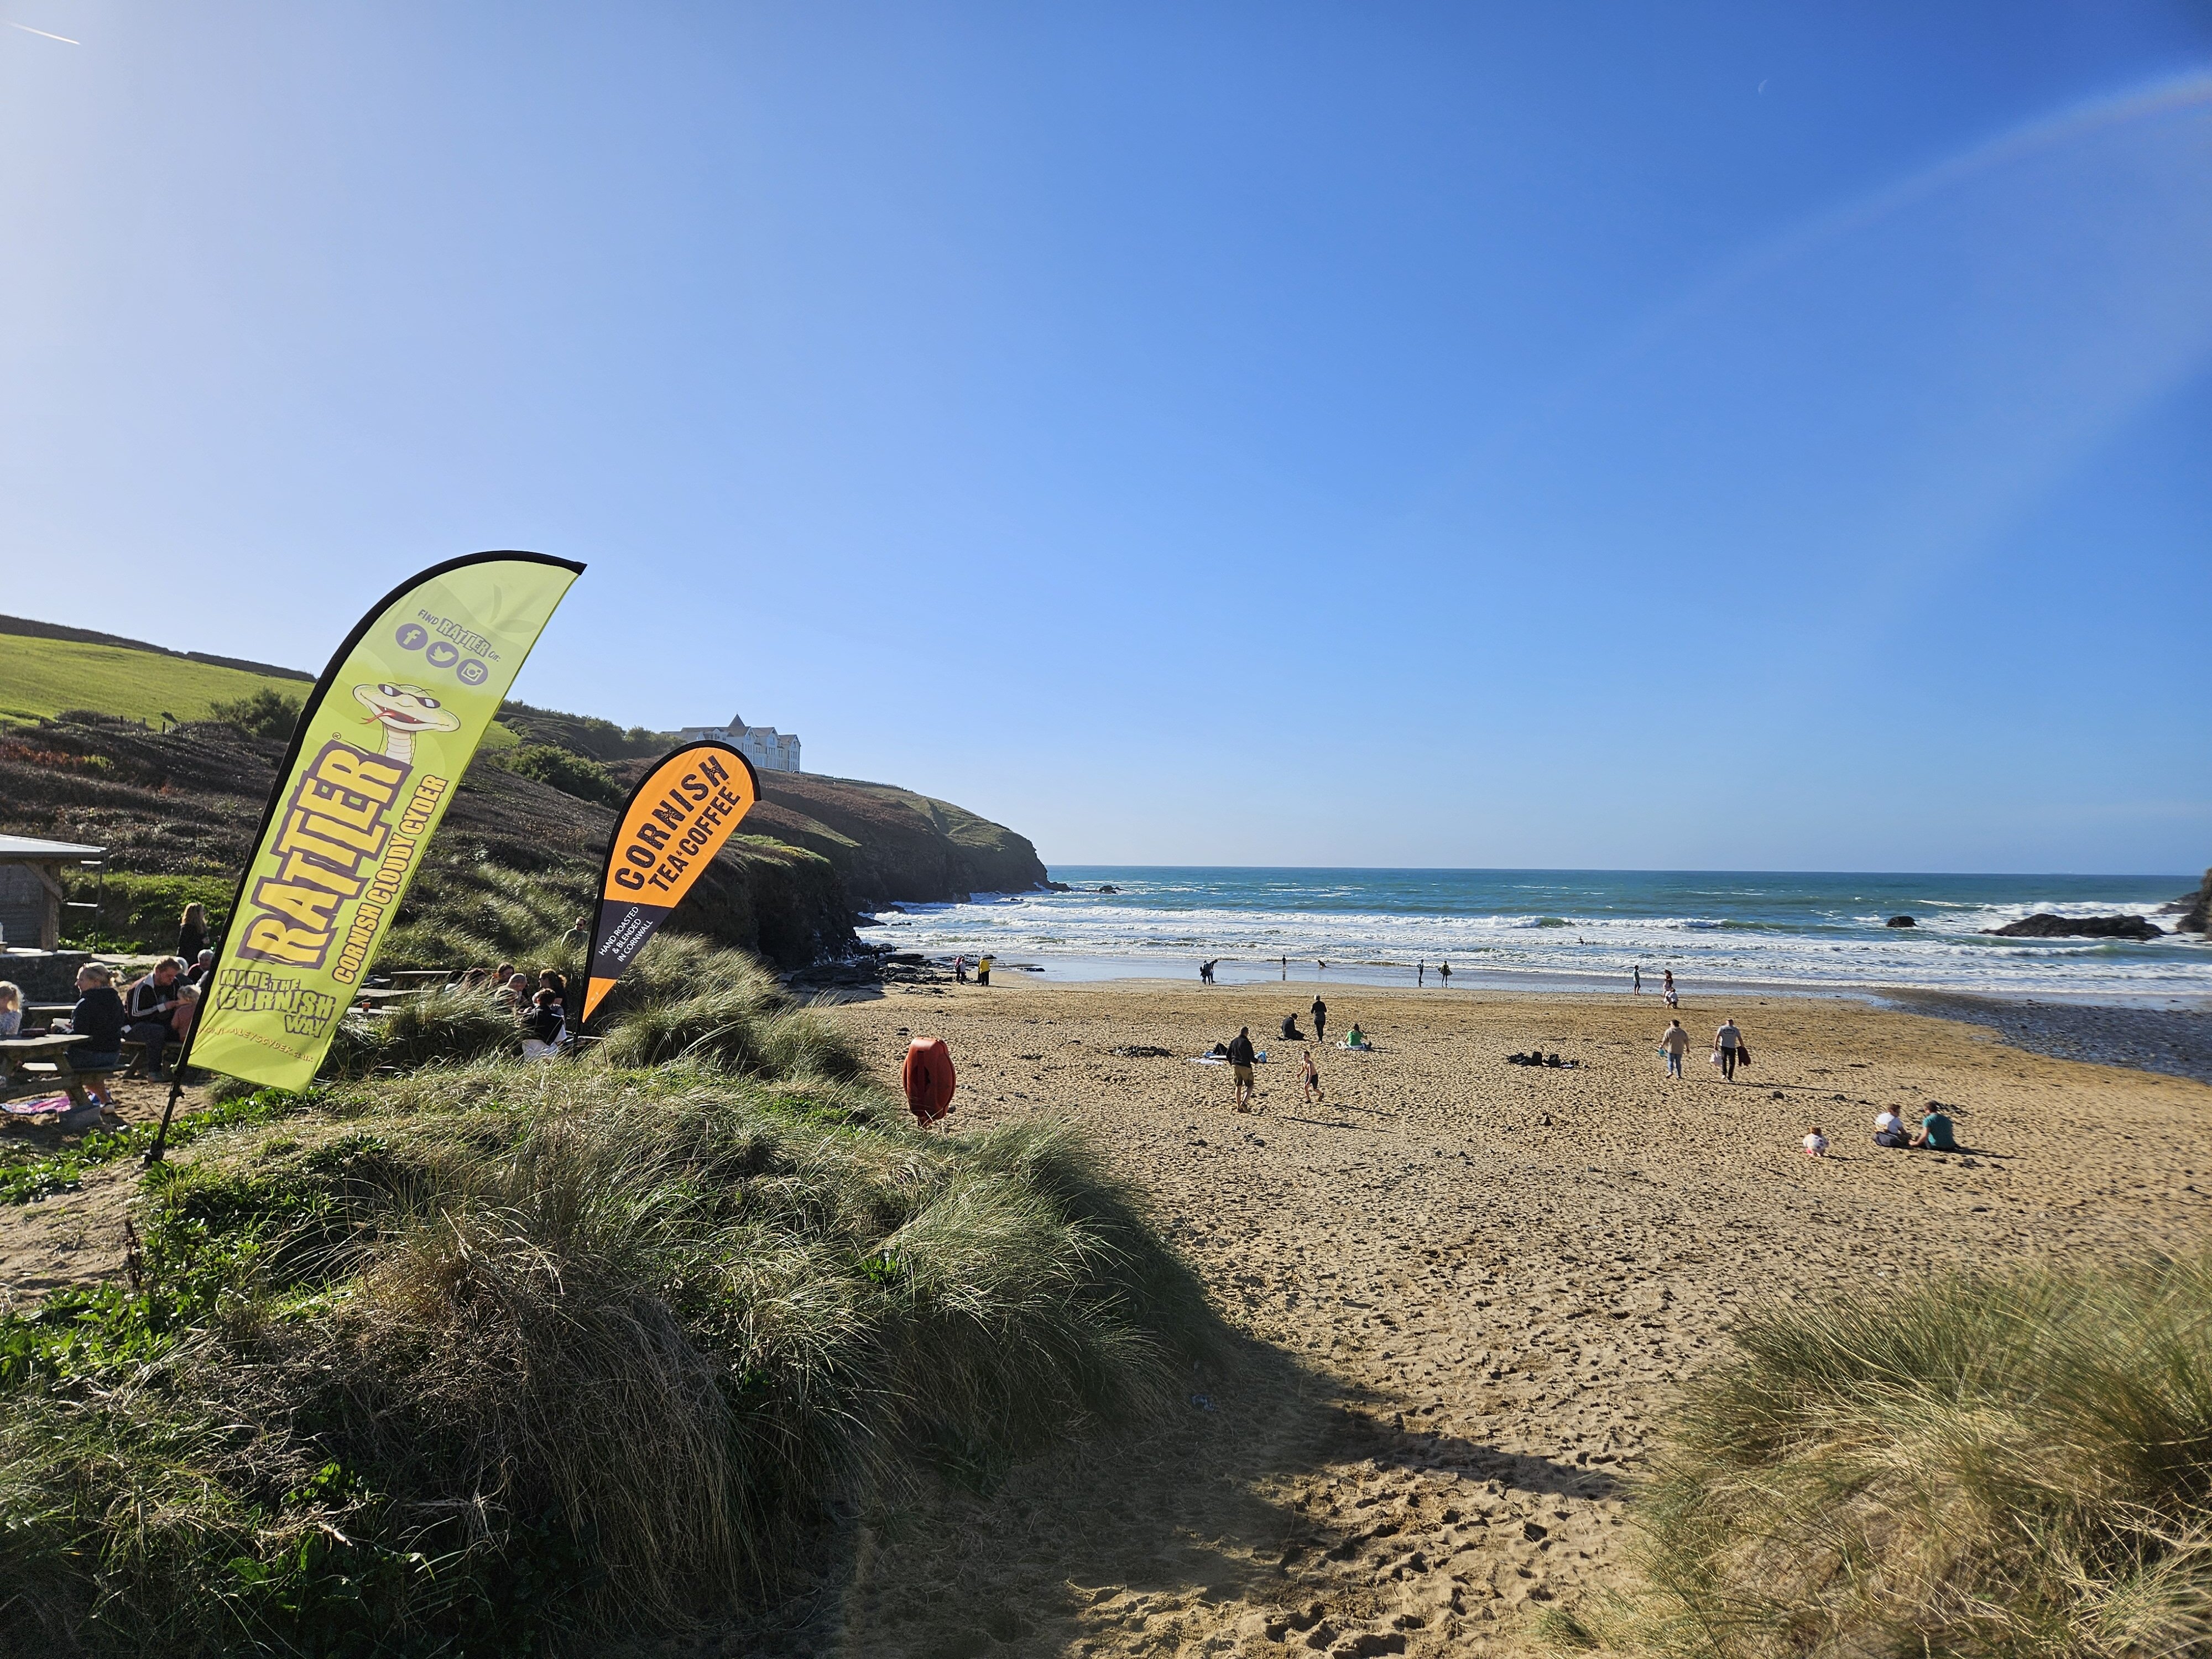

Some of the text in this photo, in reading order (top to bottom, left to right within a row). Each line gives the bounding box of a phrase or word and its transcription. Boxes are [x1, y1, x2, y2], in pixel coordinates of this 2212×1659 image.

[418, 609, 439, 625] FIND
[436, 618, 491, 658] RATTLER
[614, 755, 729, 890] CORNISH
[648, 854, 689, 891] TEA
[679, 786, 741, 856] COFFEE
[236, 740, 414, 969] RATTLER
[332, 775, 448, 984] CORNISH CLOUDY CYDER
[598, 906, 639, 956] HAND ROASTED
[616, 919, 641, 948] BLENDED
[617, 920, 653, 962] IN CORNWALL
[217, 985, 336, 1021] CORNISH
[269, 978, 300, 992] THE
[285, 1015, 327, 1038] WAY
